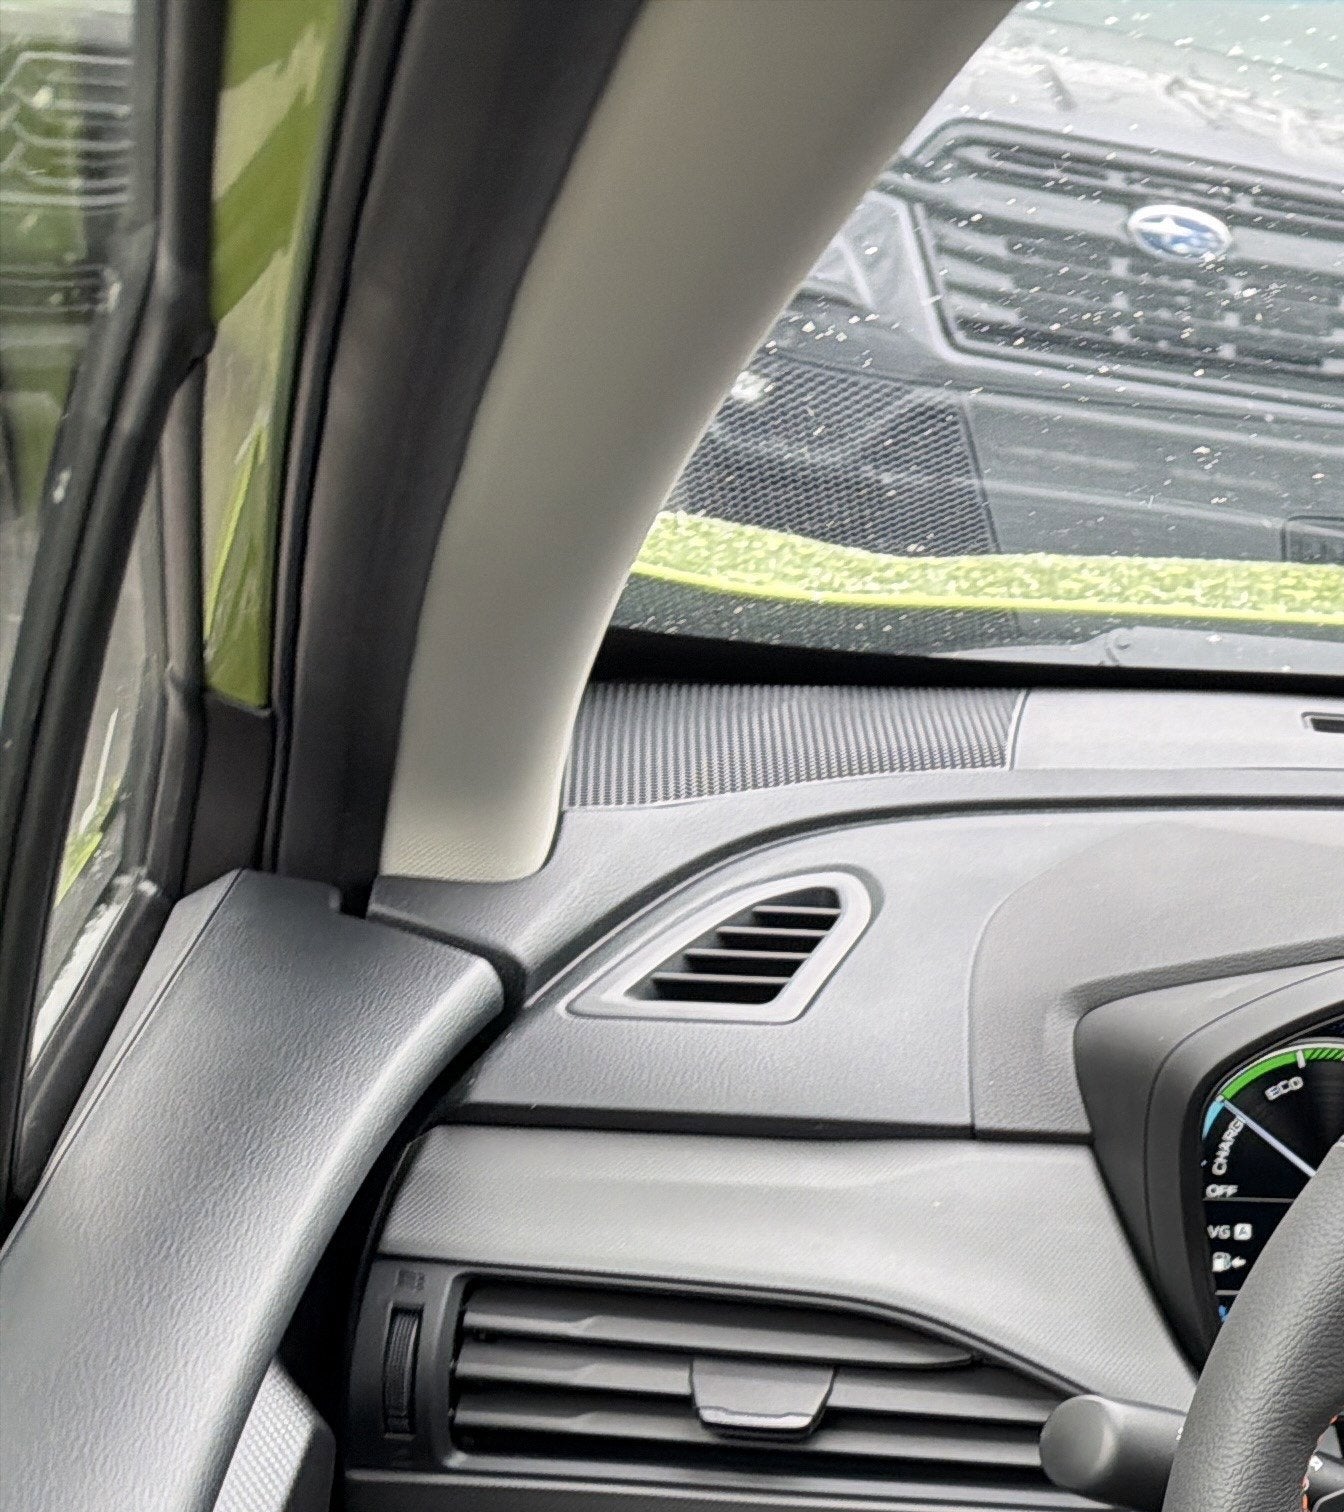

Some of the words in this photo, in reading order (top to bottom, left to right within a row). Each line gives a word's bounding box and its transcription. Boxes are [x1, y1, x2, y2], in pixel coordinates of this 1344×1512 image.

[1265, 1076, 1304, 1101] ECO
[1211, 1113, 1246, 1176] CHARG
[1205, 1183, 1239, 1199] OFF
[1207, 1224, 1231, 1239] VG
